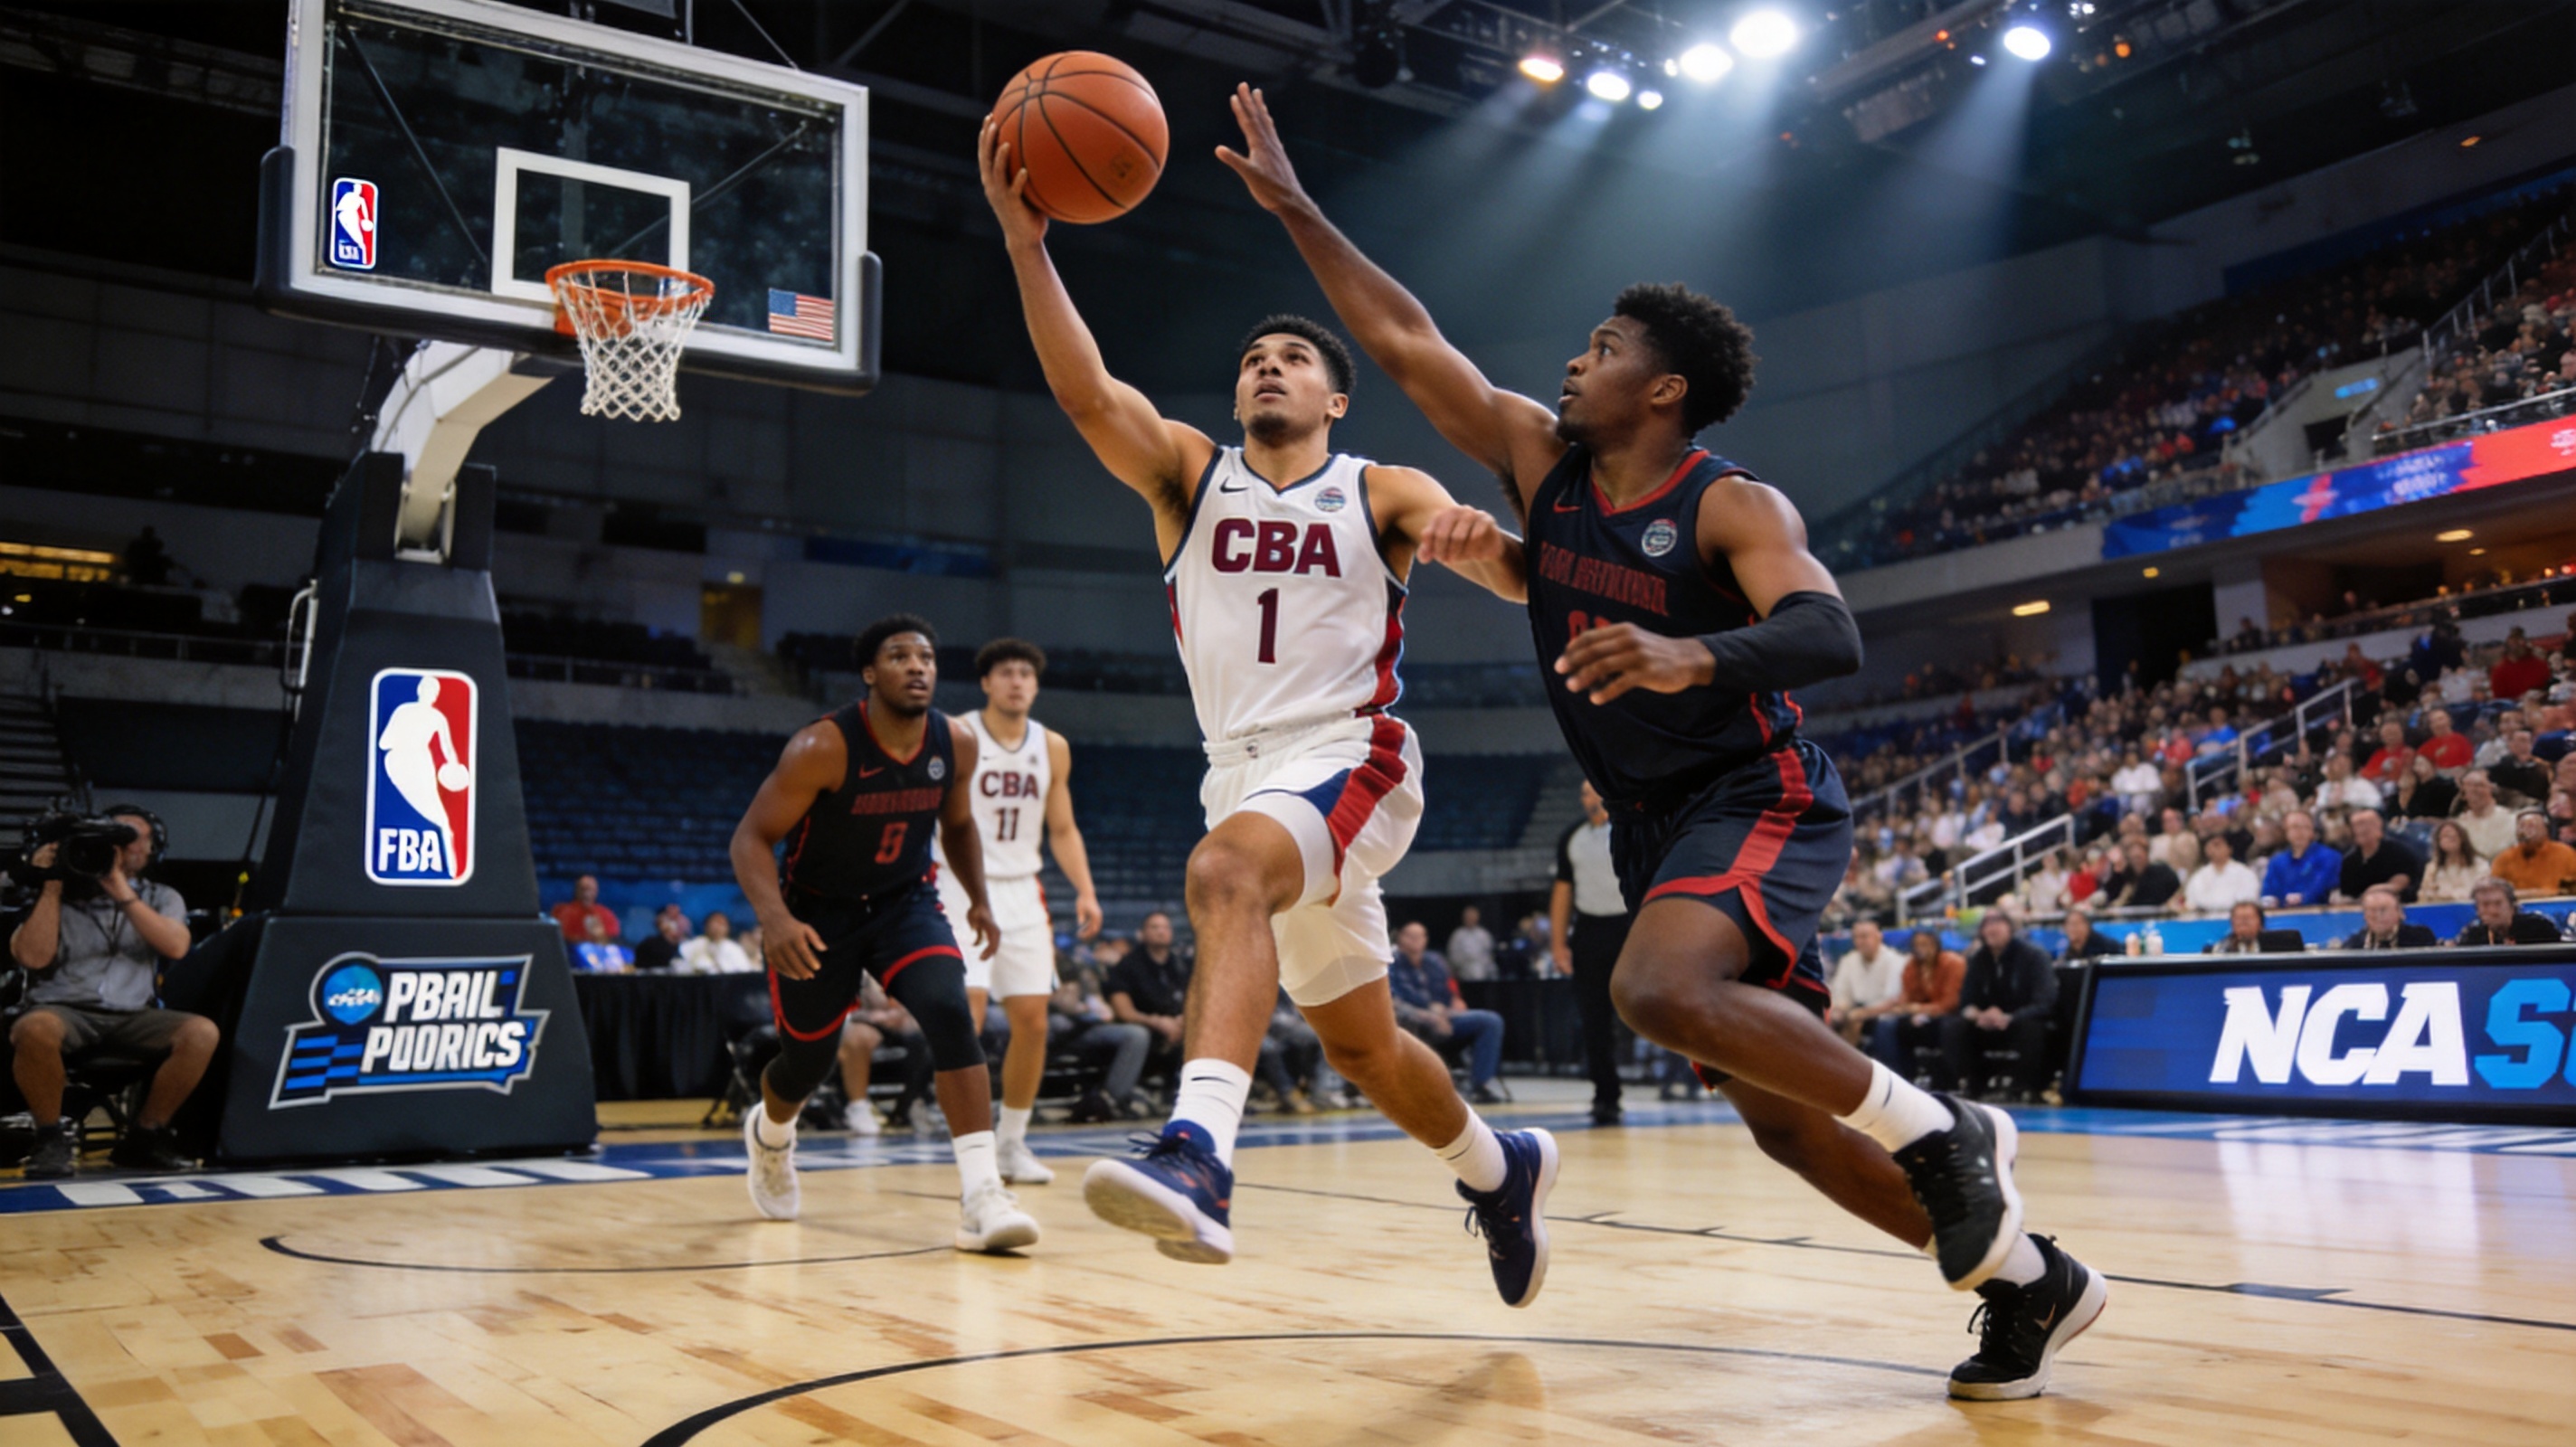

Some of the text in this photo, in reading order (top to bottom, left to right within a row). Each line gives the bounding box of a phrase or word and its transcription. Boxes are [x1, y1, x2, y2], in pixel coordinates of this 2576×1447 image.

[1211, 517, 1341, 578] CBA
[1257, 588, 1279, 664] 1
[980, 771, 1039, 799] CBA
[378, 828, 442, 872] FBA
[996, 807, 1020, 841] 11
[2209, 978, 2576, 1090] NCA S
